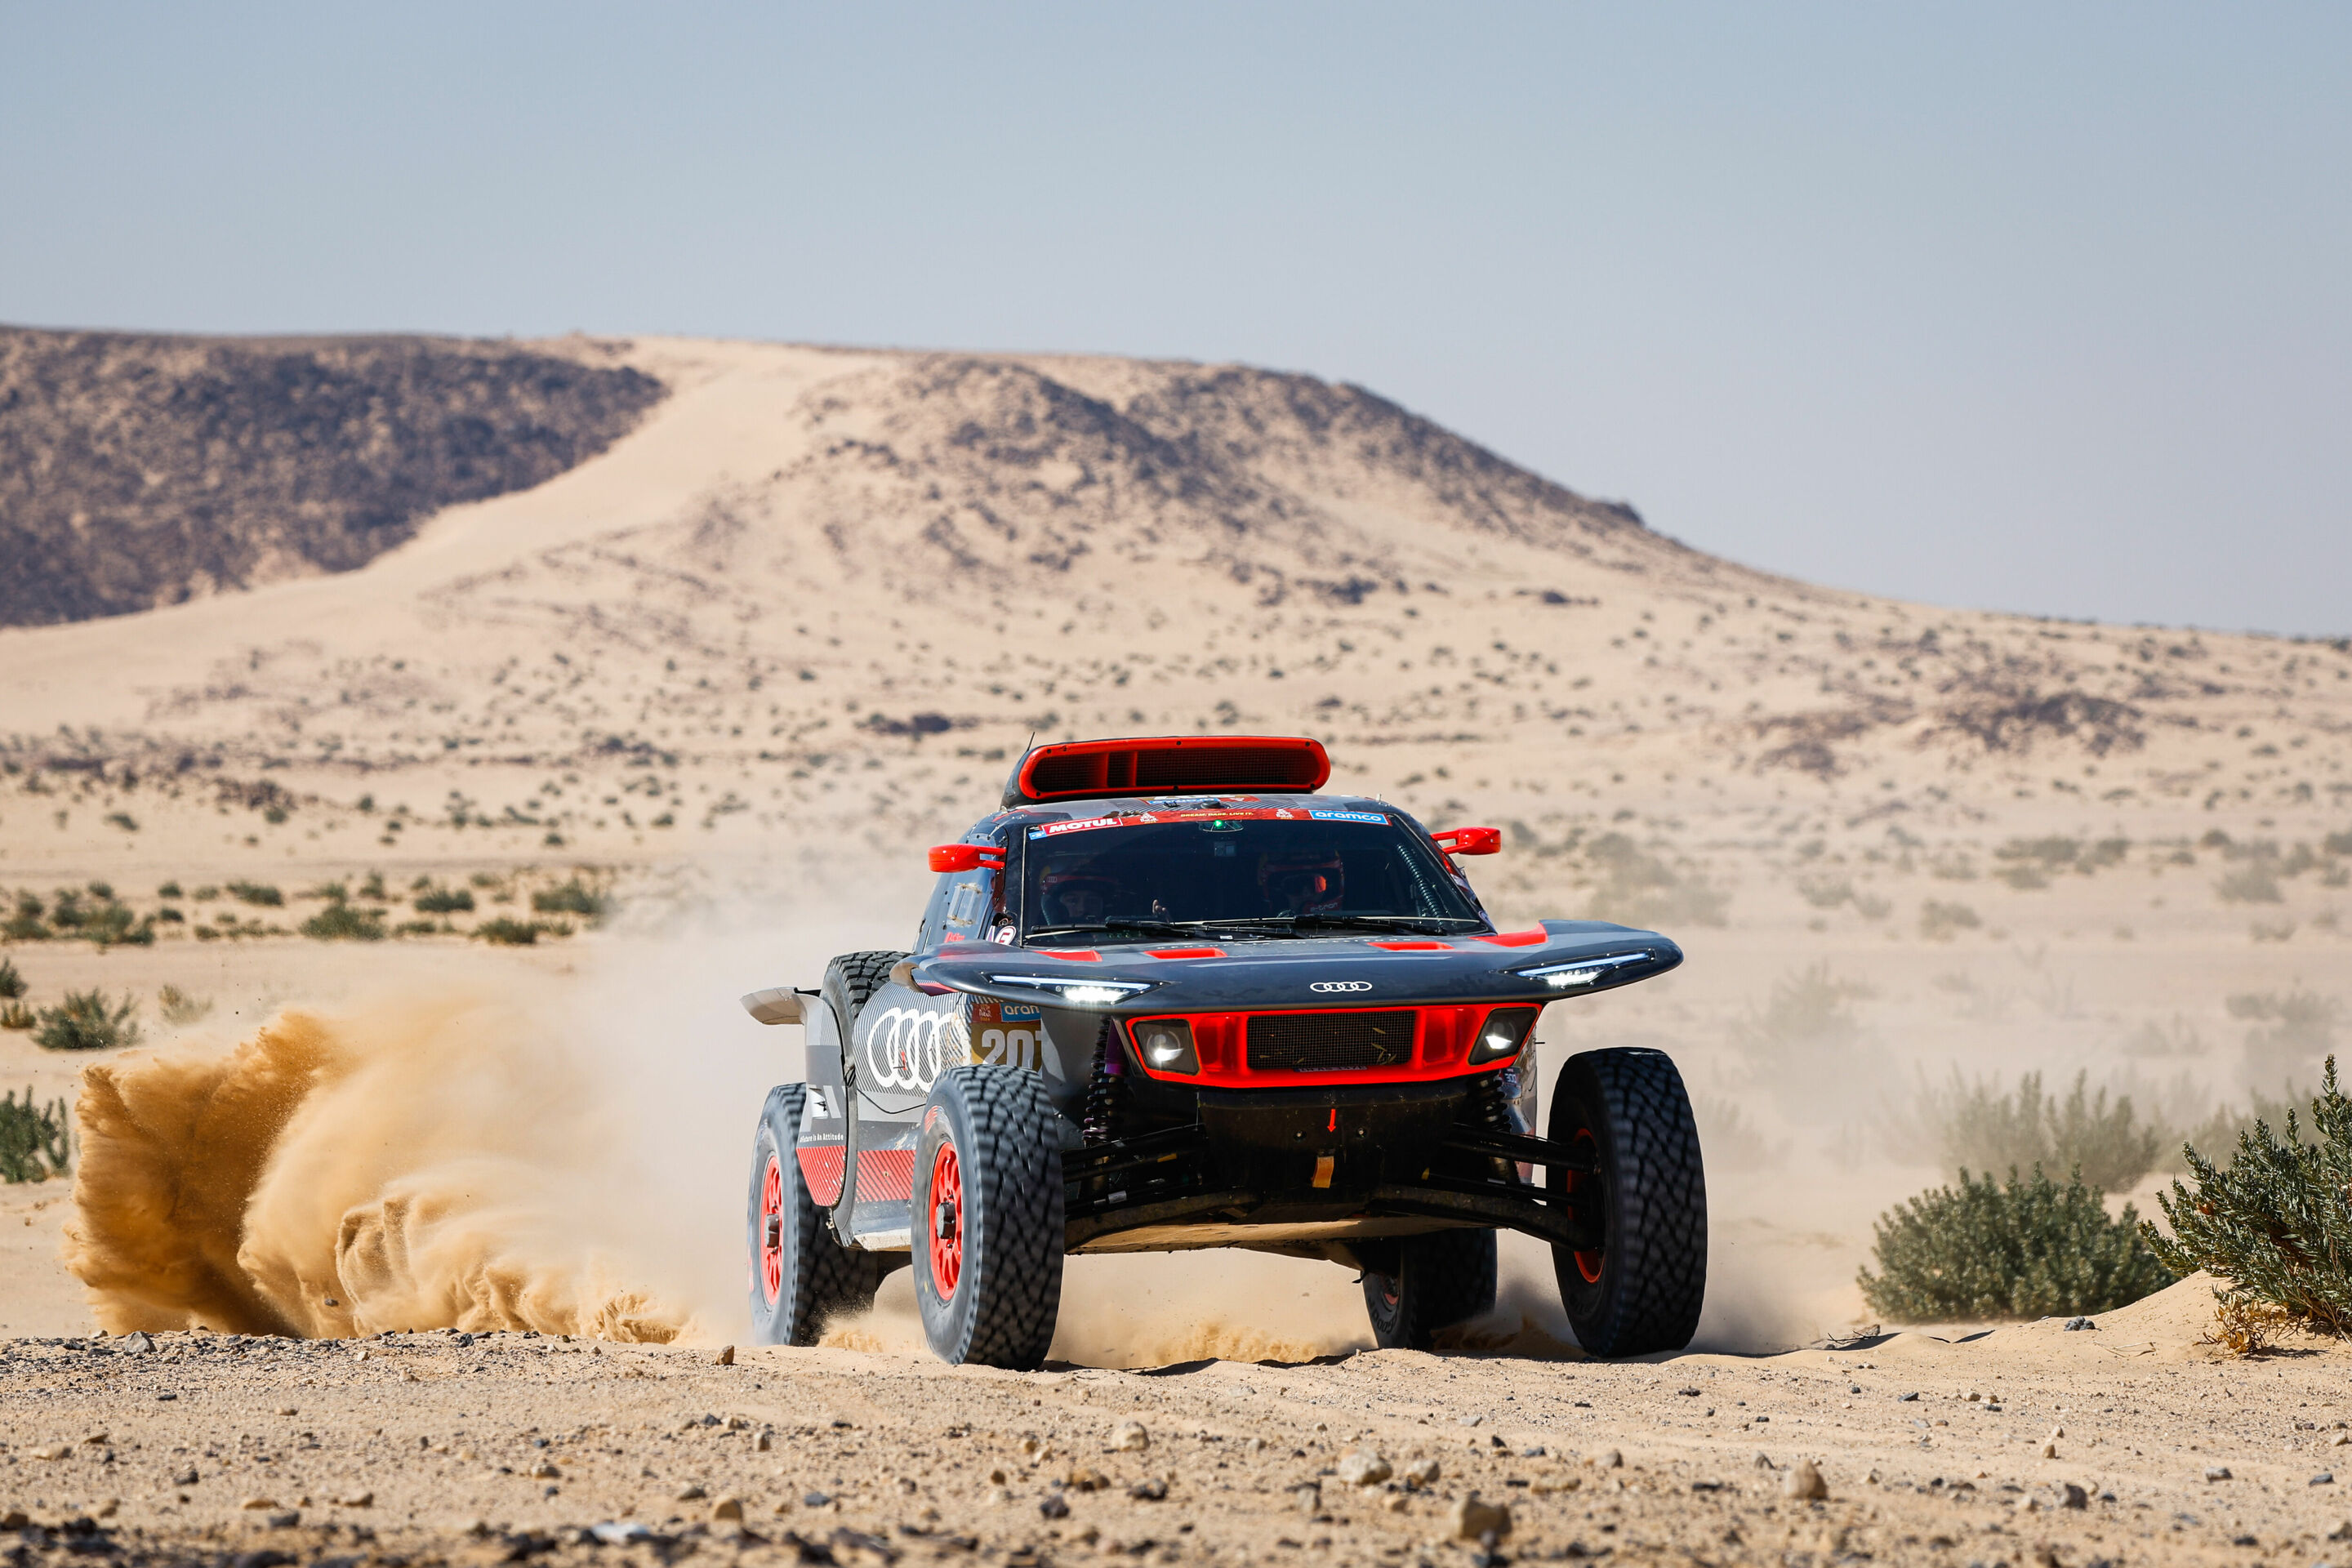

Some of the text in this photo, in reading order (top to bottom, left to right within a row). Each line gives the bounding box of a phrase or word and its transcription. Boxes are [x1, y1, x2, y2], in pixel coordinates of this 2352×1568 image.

[1315, 812, 1382, 822] aramco
[1049, 817, 1117, 833] MOTUL
[822, 1132, 844, 1141] Attitude
